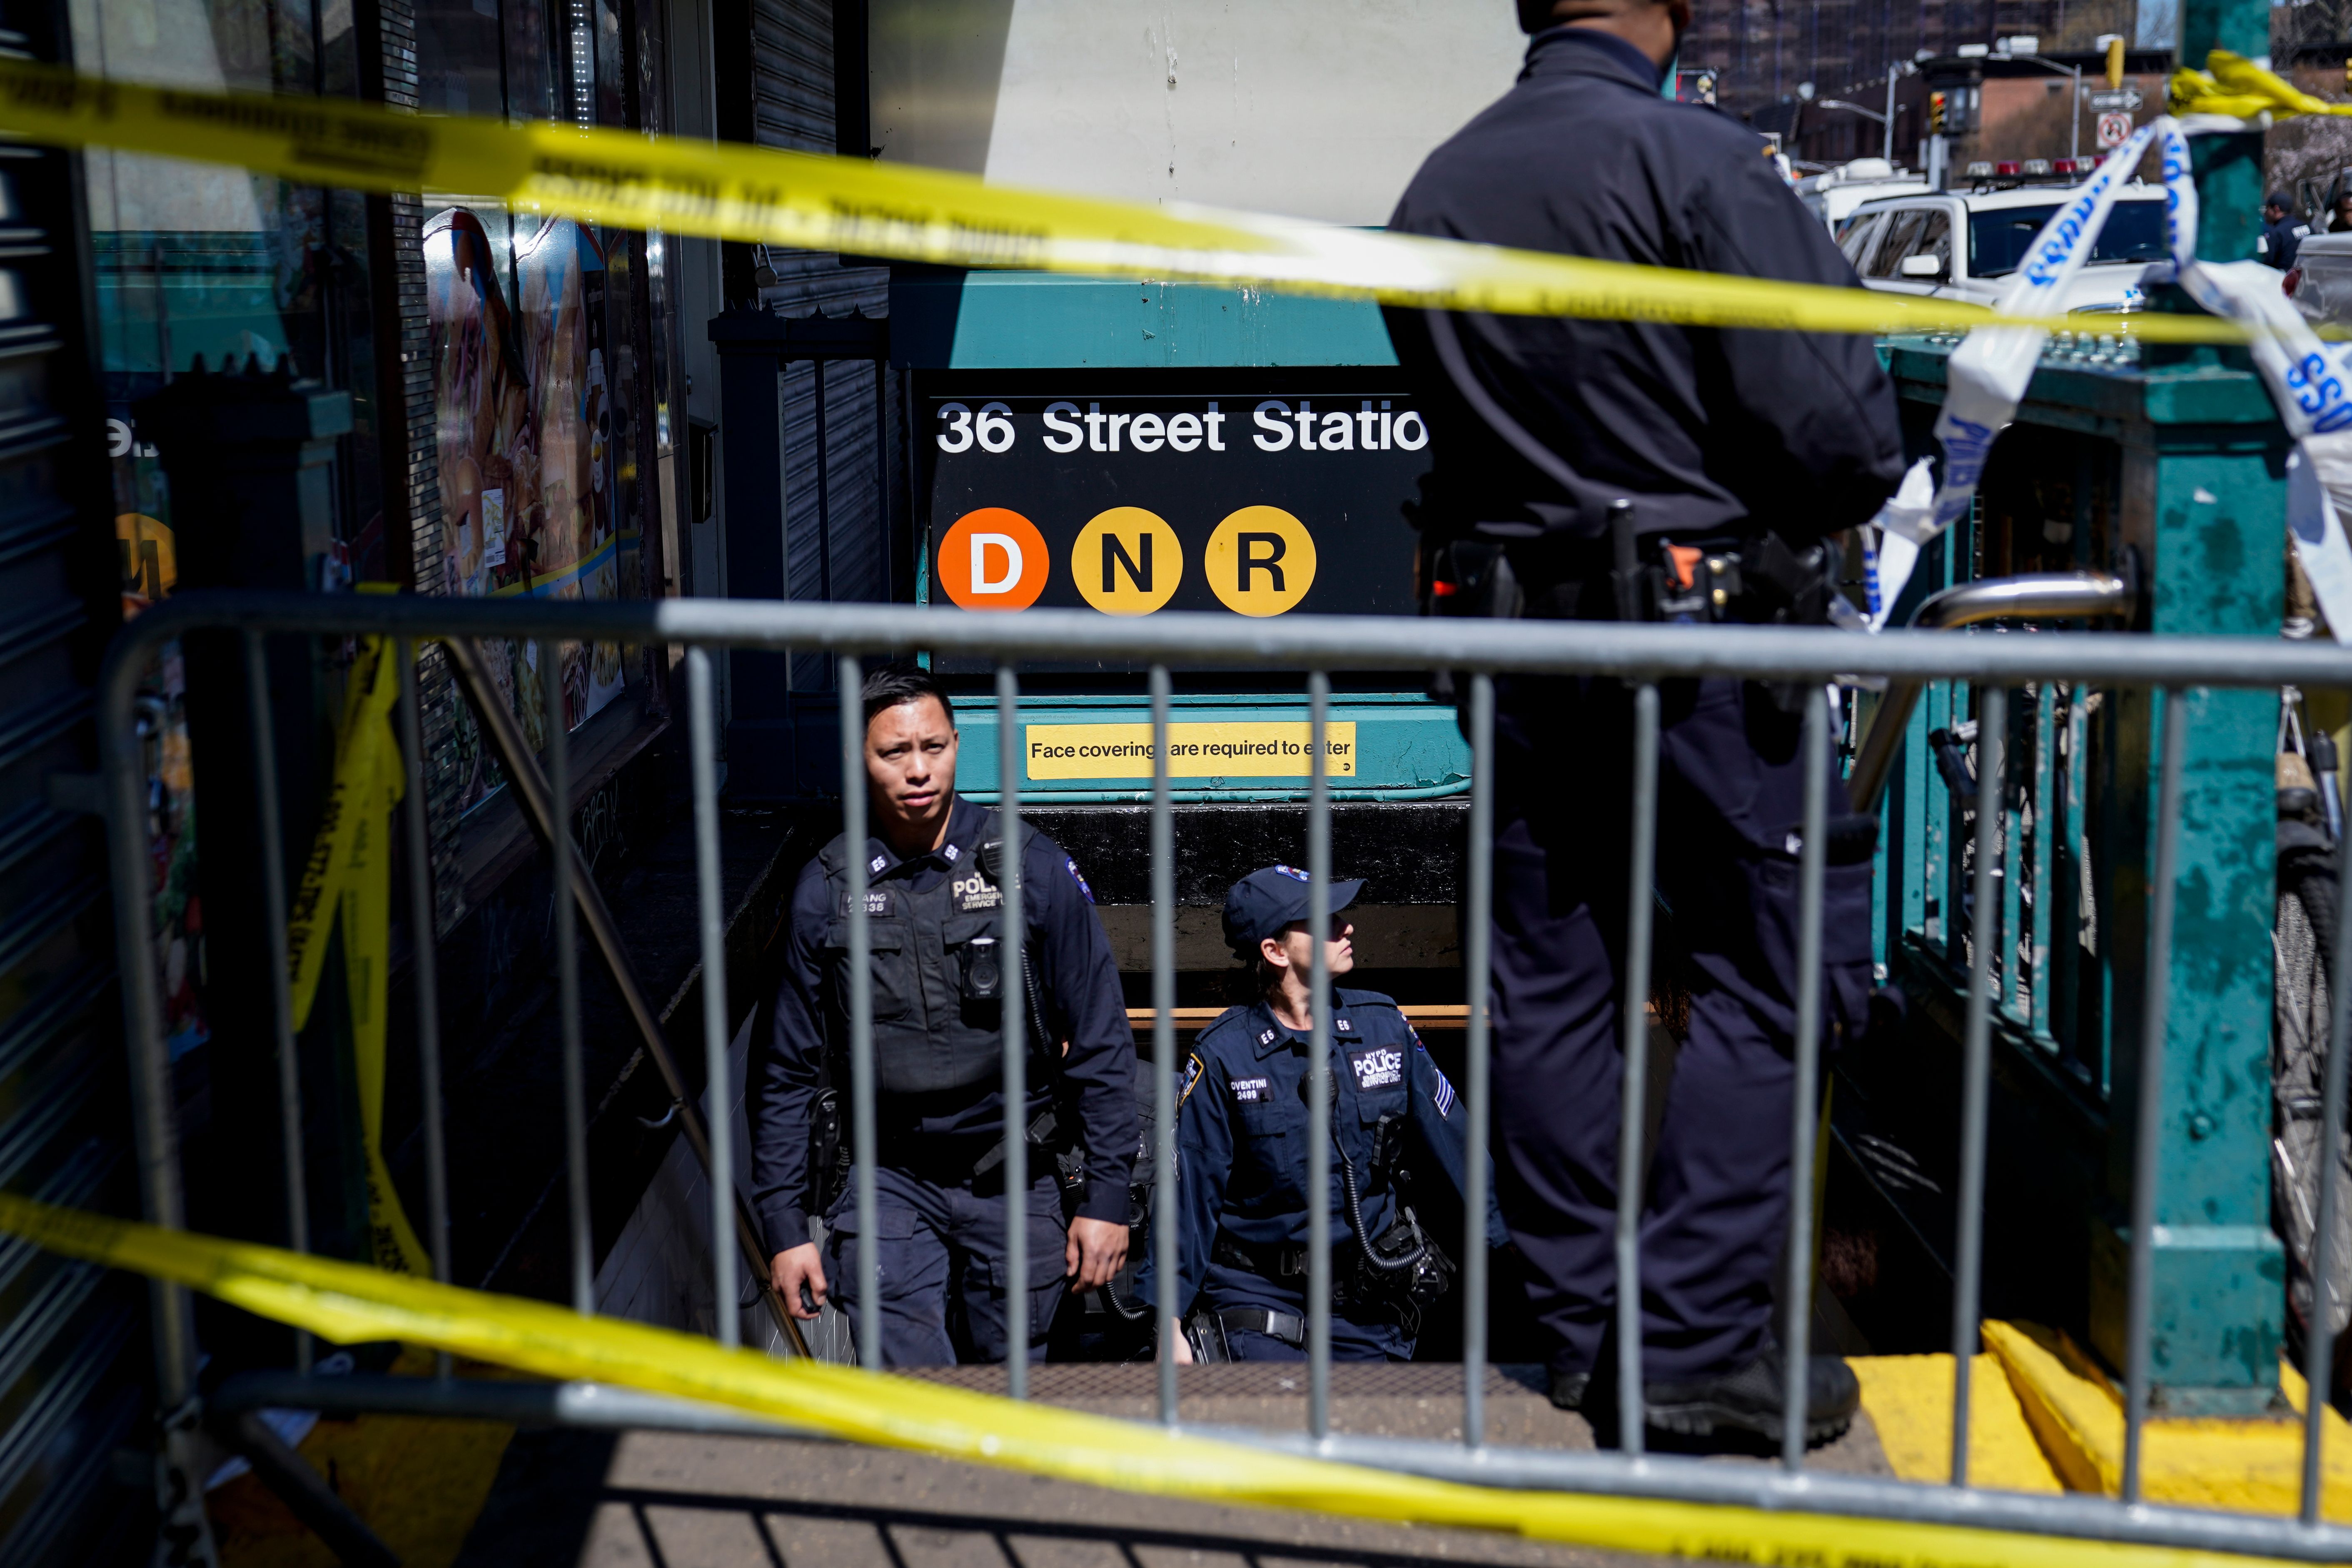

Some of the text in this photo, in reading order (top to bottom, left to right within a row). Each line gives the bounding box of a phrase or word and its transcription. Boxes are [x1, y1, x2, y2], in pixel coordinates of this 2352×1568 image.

[936, 400, 1429, 453] 36 Street Statio
[970, 532, 1286, 593] D N R
[1031, 740, 1350, 760] Face covering are required to eter
[945, 844, 958, 860] E6
[871, 856, 885, 872] E6
[847, 893, 886, 903] HANG
[965, 892, 1003, 902] EMERGEN
[848, 902, 884, 912] 2338
[962, 899, 996, 910] SERVICE
[1337, 1020, 1349, 1031] E6
[1261, 1030, 1274, 1044] E6
[1365, 1049, 1386, 1059] NYPD
[1354, 1052, 1402, 1077] POLICE
[1362, 1074, 1401, 1088] SERVICE UNIT
[1363, 1070, 1399, 1082] EMERGENCY
[1231, 1079, 1267, 1090] OVENTINI
[1237, 1090, 1257, 1100] 2499
